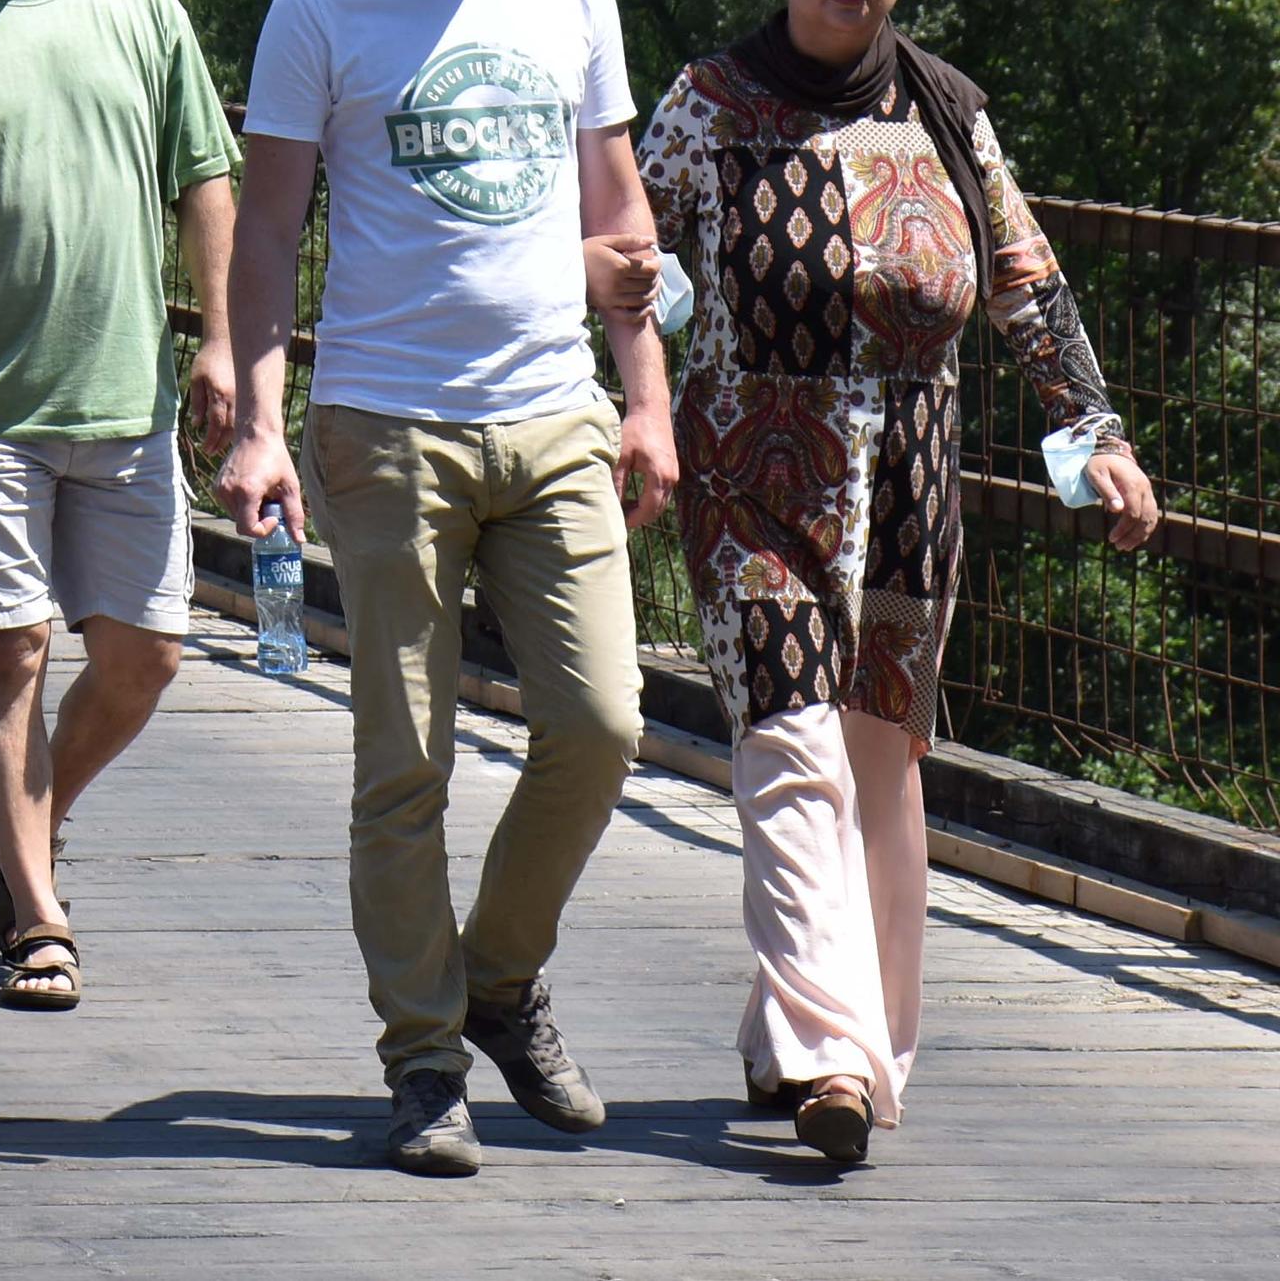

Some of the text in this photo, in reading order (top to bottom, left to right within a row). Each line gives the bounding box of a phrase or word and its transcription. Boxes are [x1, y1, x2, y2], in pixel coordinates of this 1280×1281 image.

[427, 67, 464, 102] CATCH
[467, 60, 493, 77] THE
[394, 113, 547, 157] BLOCKS
[436, 169, 480, 202] WAVES
[271, 560, 302, 573] aqua
[274, 572, 301, 583] viva
